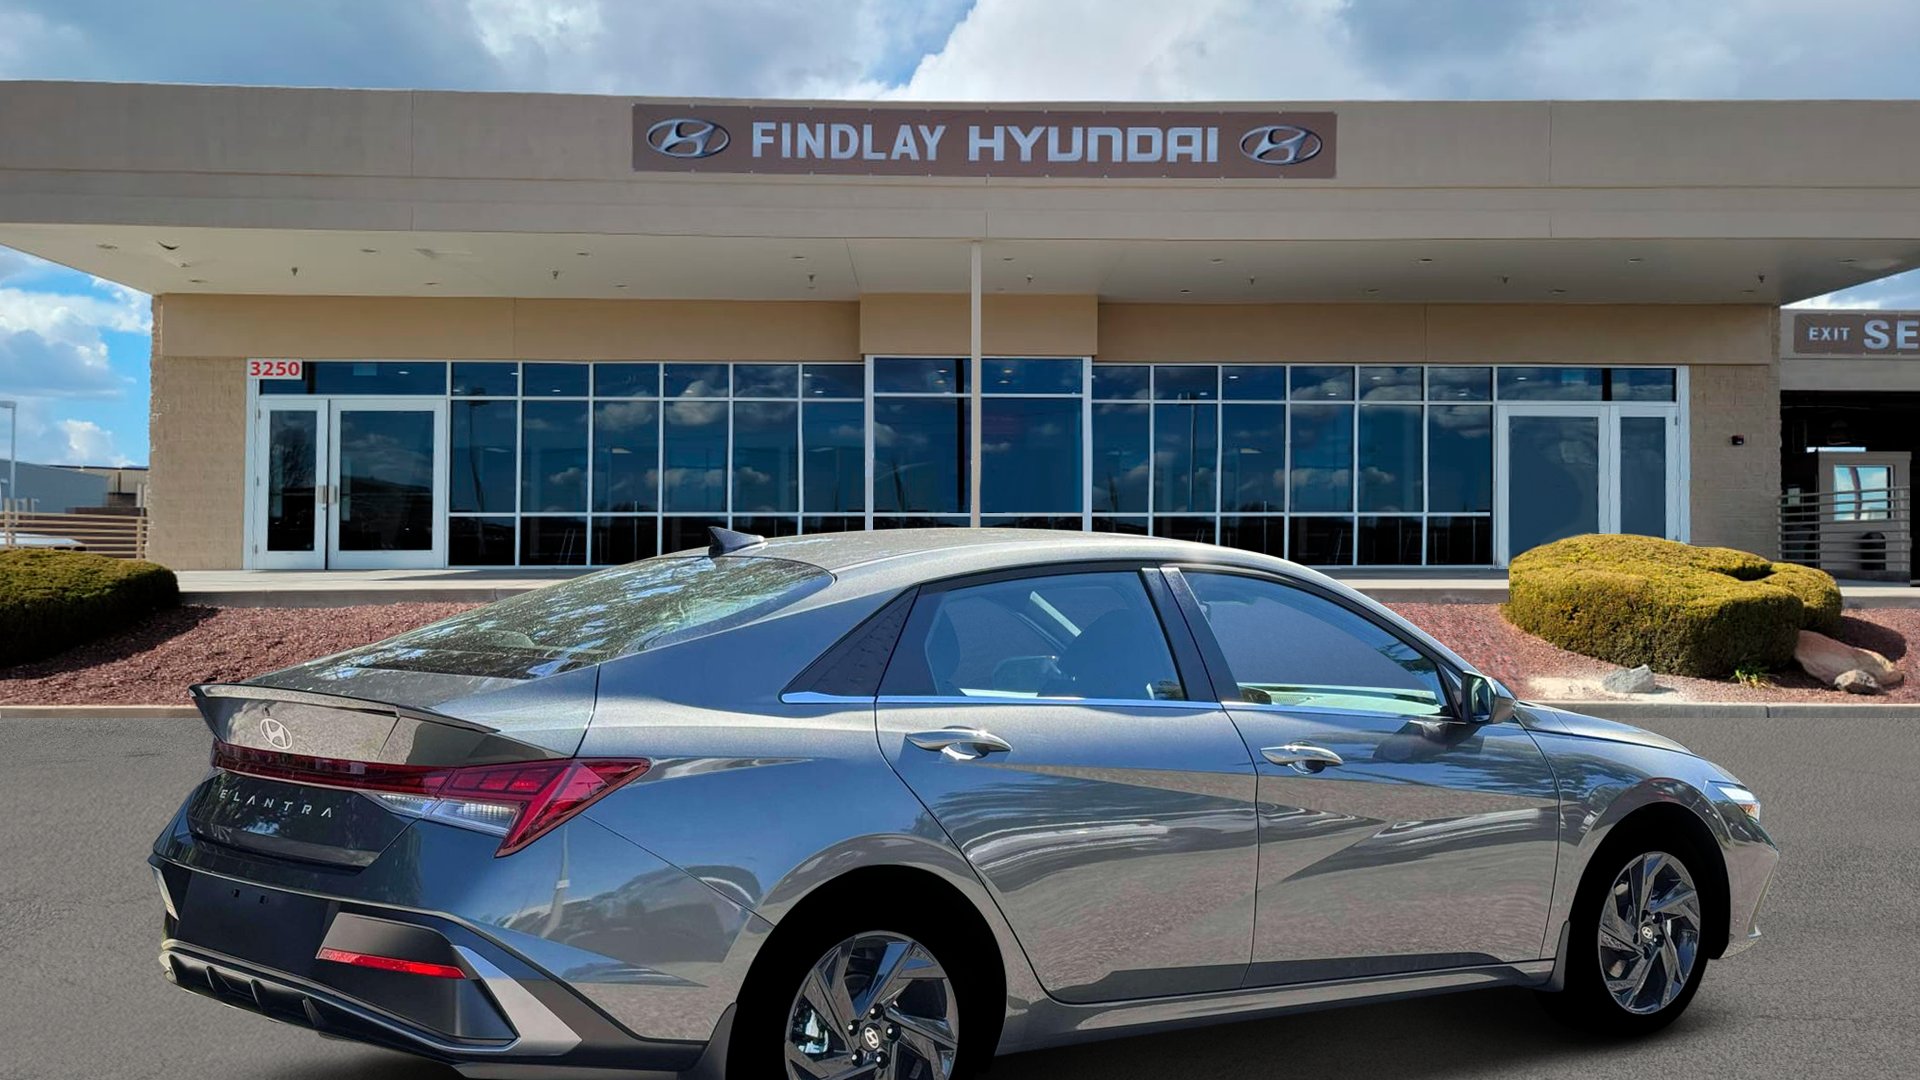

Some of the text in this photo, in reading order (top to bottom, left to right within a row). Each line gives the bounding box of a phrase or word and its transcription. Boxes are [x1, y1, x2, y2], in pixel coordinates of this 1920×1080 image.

[751, 121, 1219, 163] FINDLAY HYUNDAI
[1808, 326, 1851, 341] EXIT
[249, 361, 300, 376] 3250
[219, 788, 333, 819] ELANTRA
